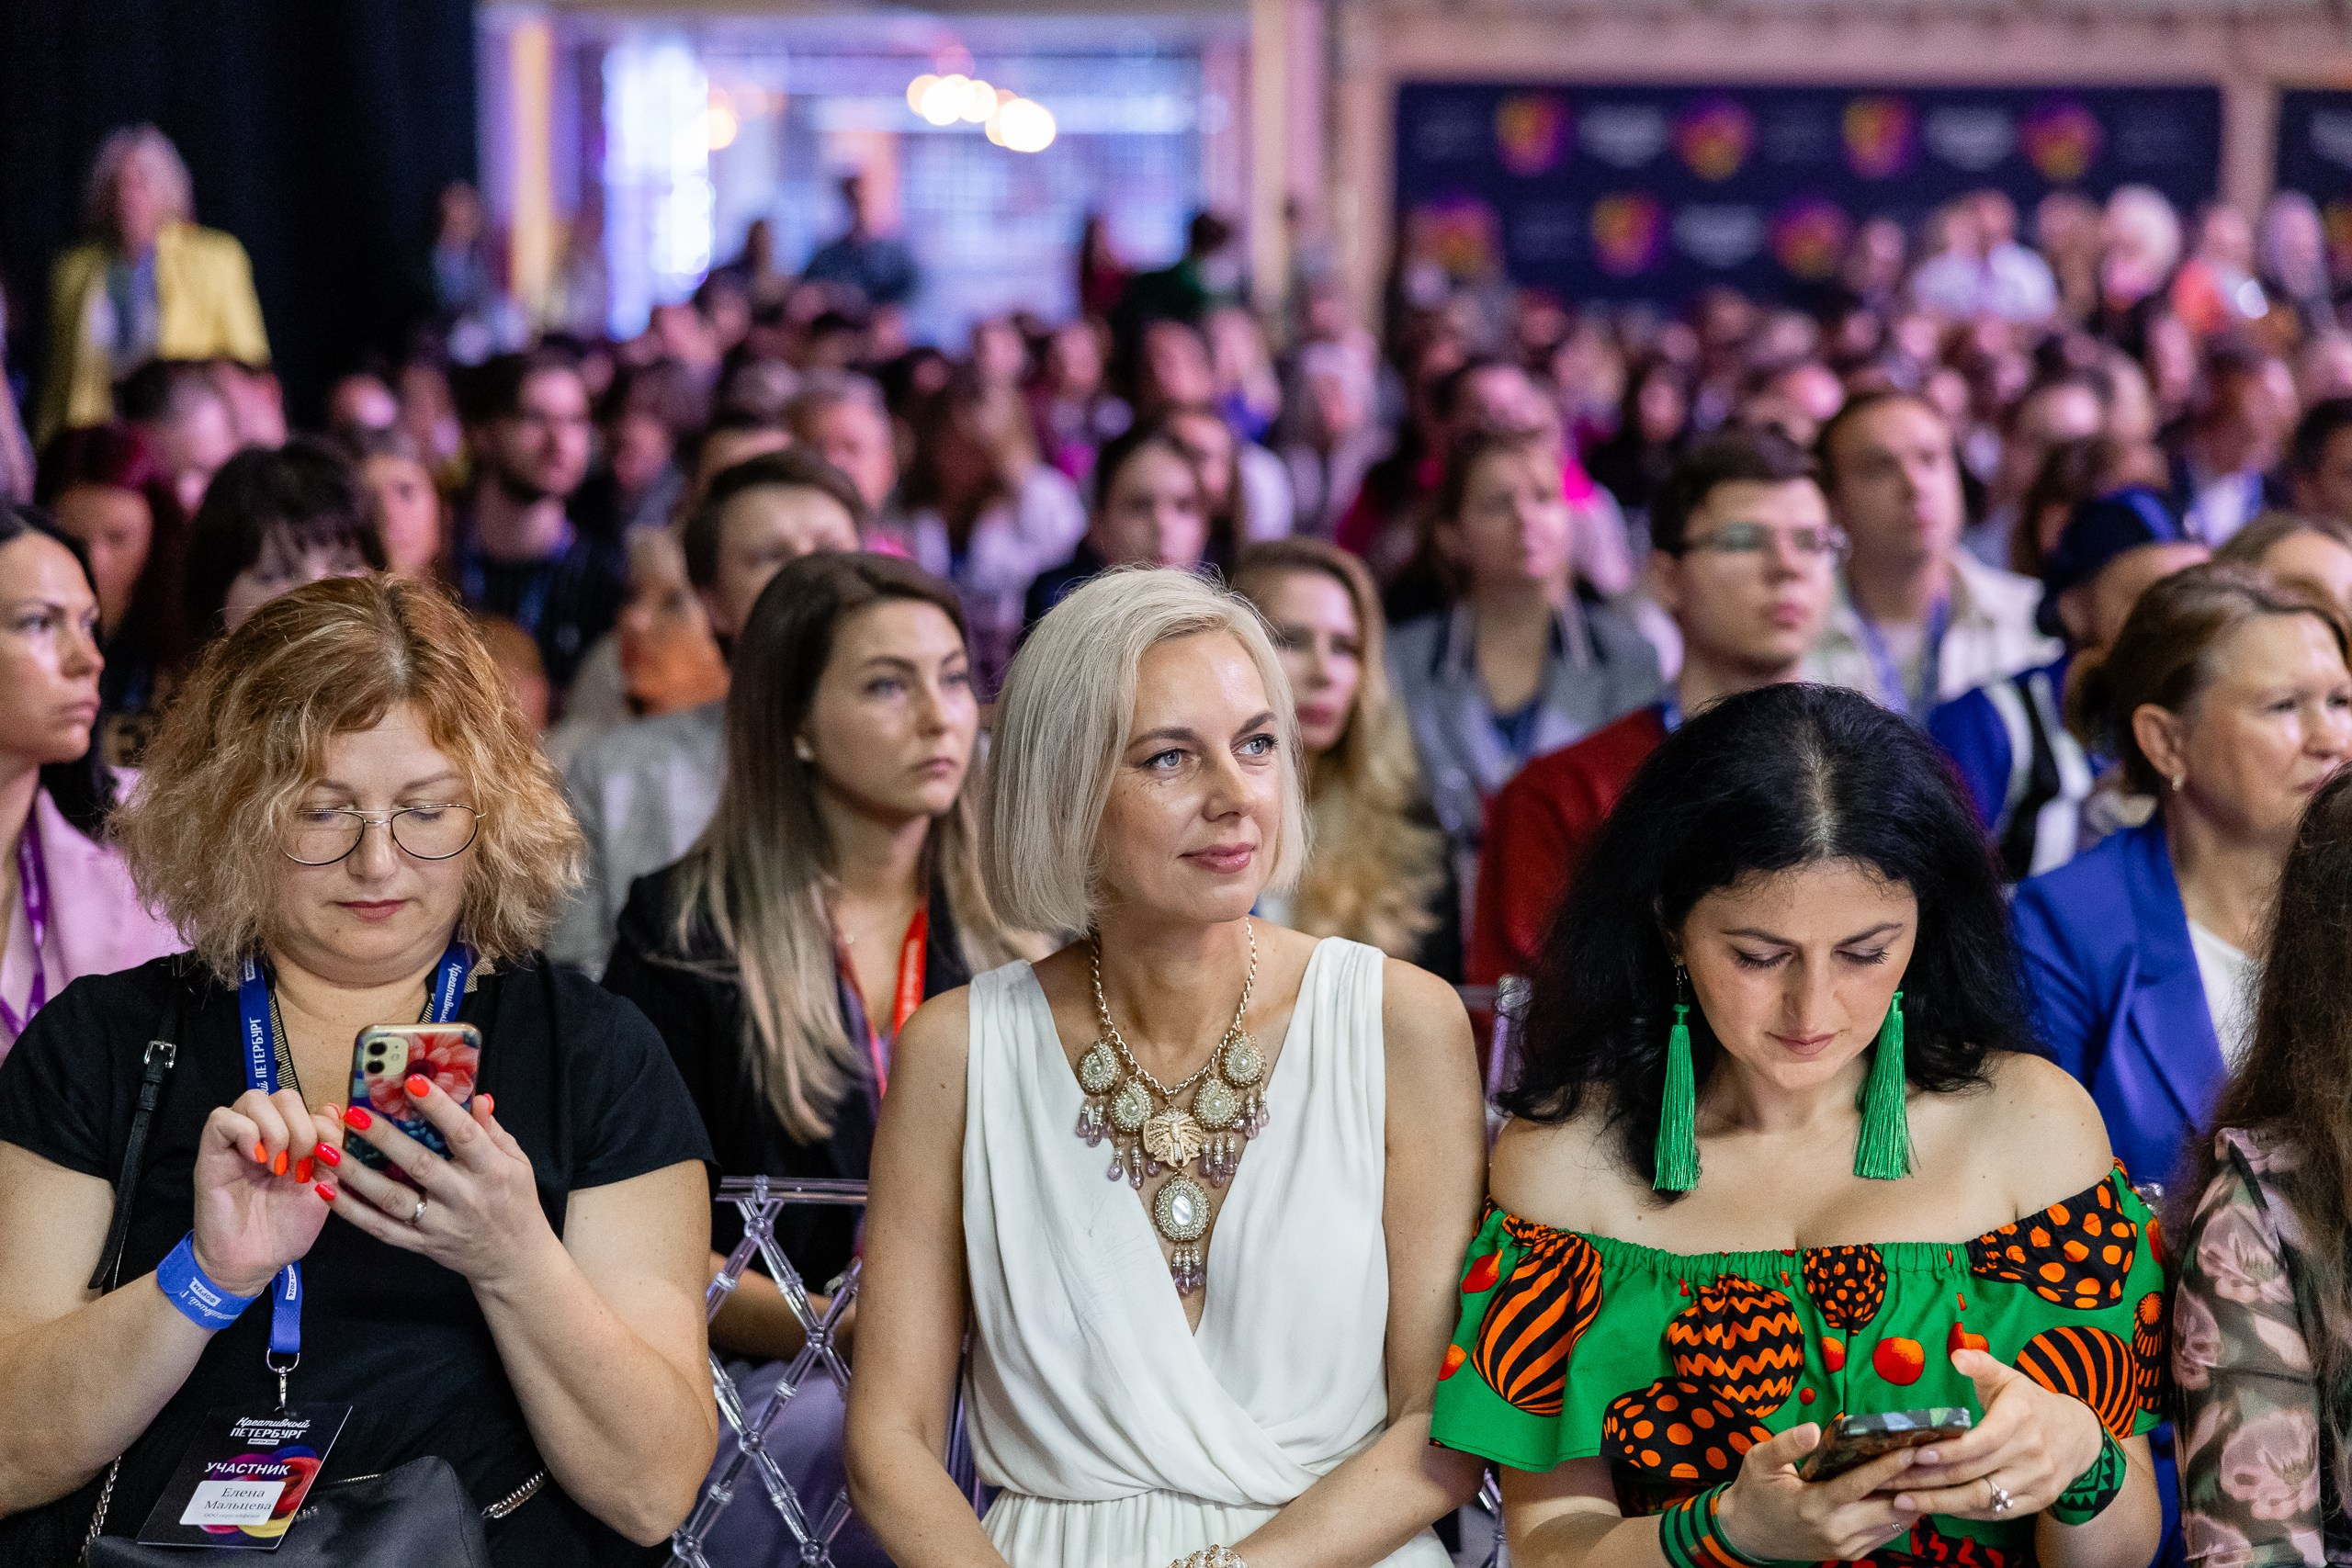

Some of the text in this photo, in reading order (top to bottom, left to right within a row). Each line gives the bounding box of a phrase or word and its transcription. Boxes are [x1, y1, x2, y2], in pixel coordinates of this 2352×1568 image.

[249, 1017, 267, 1078] ПЕТЕРБУРГ
[193, 1282, 217, 1303] ФОРУМ
[235, 1416, 311, 1428] Креативный
[230, 1427, 307, 1438] ПЕТЕРБУРГ
[204, 1462, 291, 1475] УЧАСТНИК
[221, 1487, 266, 1497] Елена
[203, 1500, 272, 1510] Мальцева
